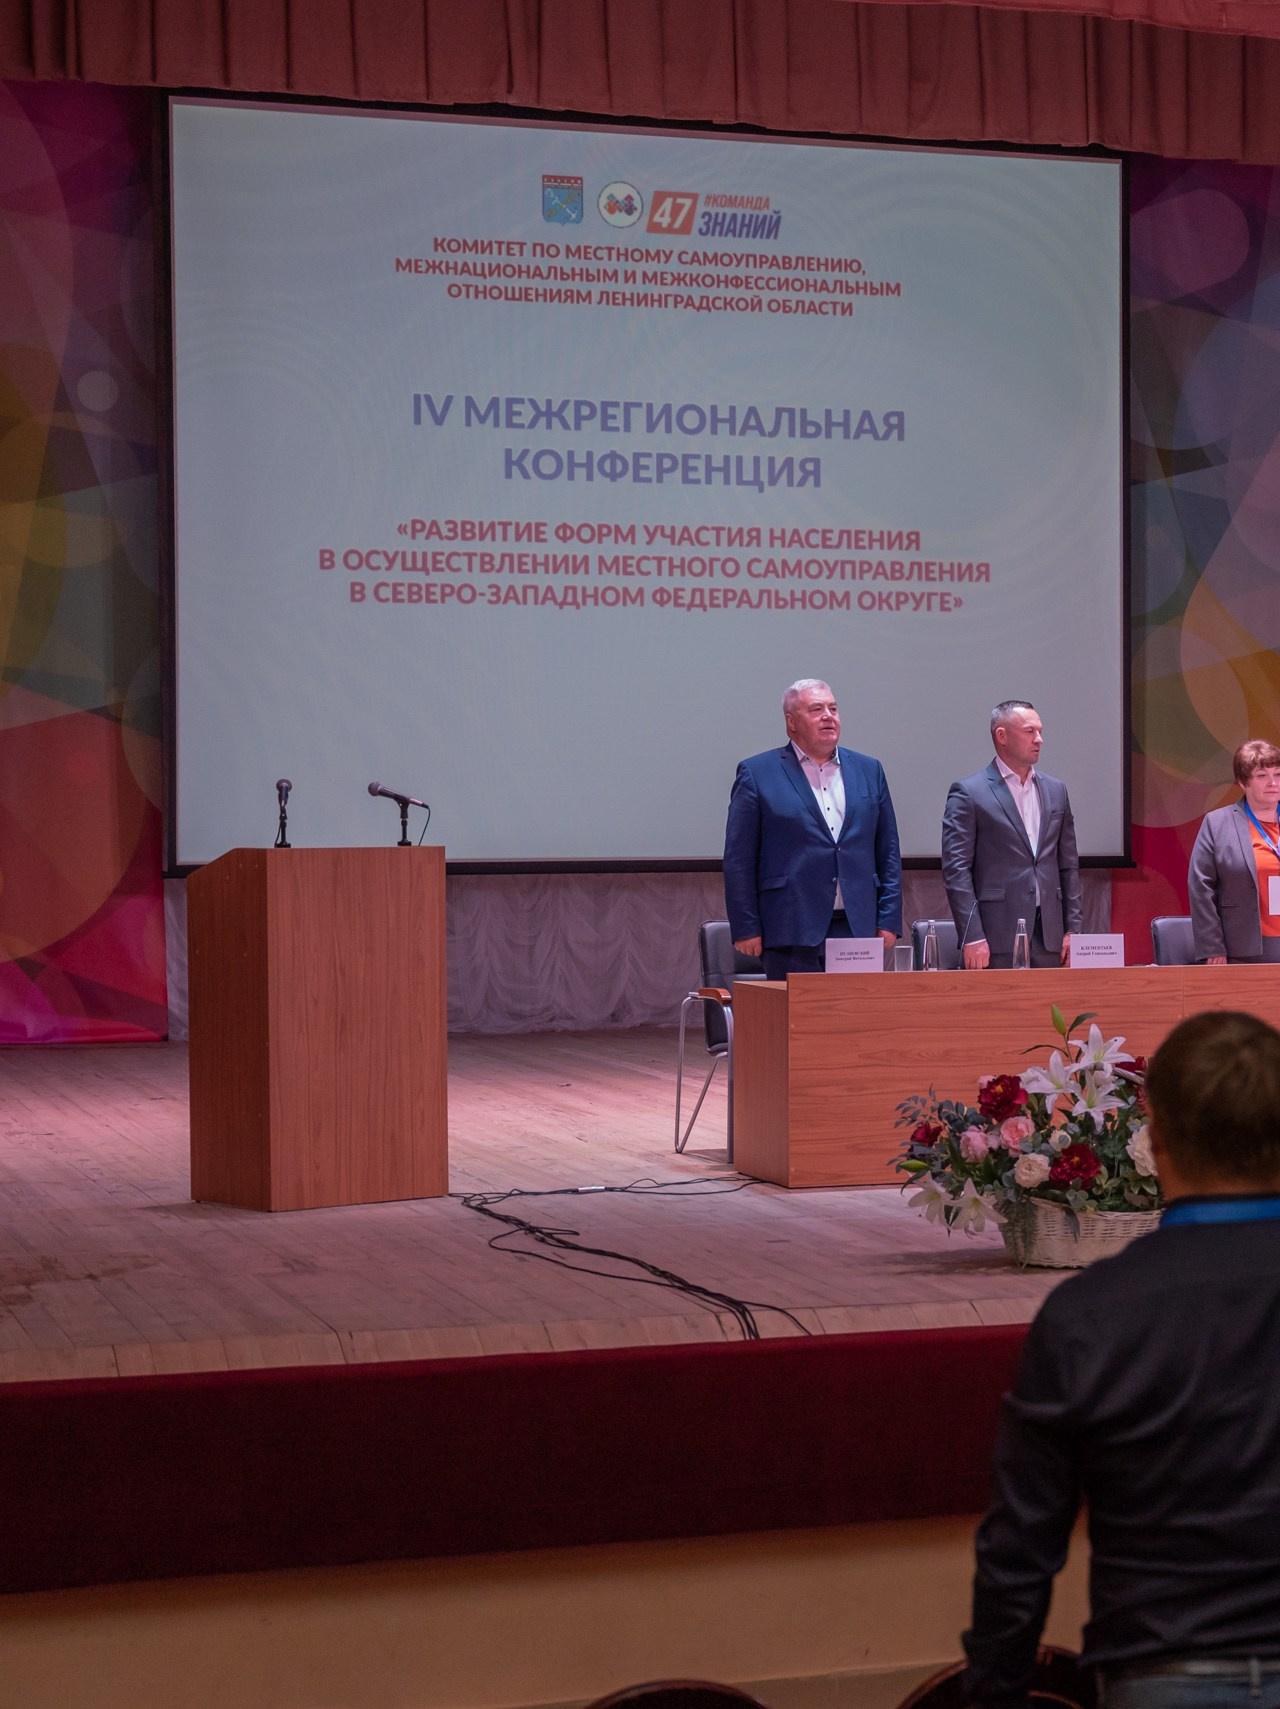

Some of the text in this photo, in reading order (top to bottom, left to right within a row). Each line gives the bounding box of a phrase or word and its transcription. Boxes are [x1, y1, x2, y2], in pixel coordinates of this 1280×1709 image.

[653, 196, 694, 231] 47
[704, 193, 769, 211] #КОМАНДА
[698, 210, 782, 240] ЗНАНИЙ
[434, 238, 865, 275] КОМИТЕТ ПО МЕСТНОМУ САМОУПРАВЛЕНИЮ,
[396, 258, 900, 296] МЕЖНАЦИОНАЛЬНЫМ И МЕЖКОНФЕССИОНАЛЬНЫМ
[448, 284, 853, 316] ОТНОШЕНИЯМ ЛЕНИНГРАДСКОЙ ОБЛАСТИ
[413, 394, 904, 441] IV МЕЖРЕГИОНАЛЬНАЯ
[505, 448, 821, 493] КОНФЕРЕНЦИЯ
[397, 519, 920, 551] «РАЗВИТИЕ ФОРМ УЧАСТИЯ НАСЕЛЕНИЯ
[320, 549, 990, 582] В ОСУЩЕСТВЛЕНИИ МЕСТНОГО САМОУПРАВЛЕНИЯ
[350, 582, 963, 612] В СЕВЕРО-ЗАПАДНОМ ФЕДЕРАЛЬНОМ ОКРУГЕ»
